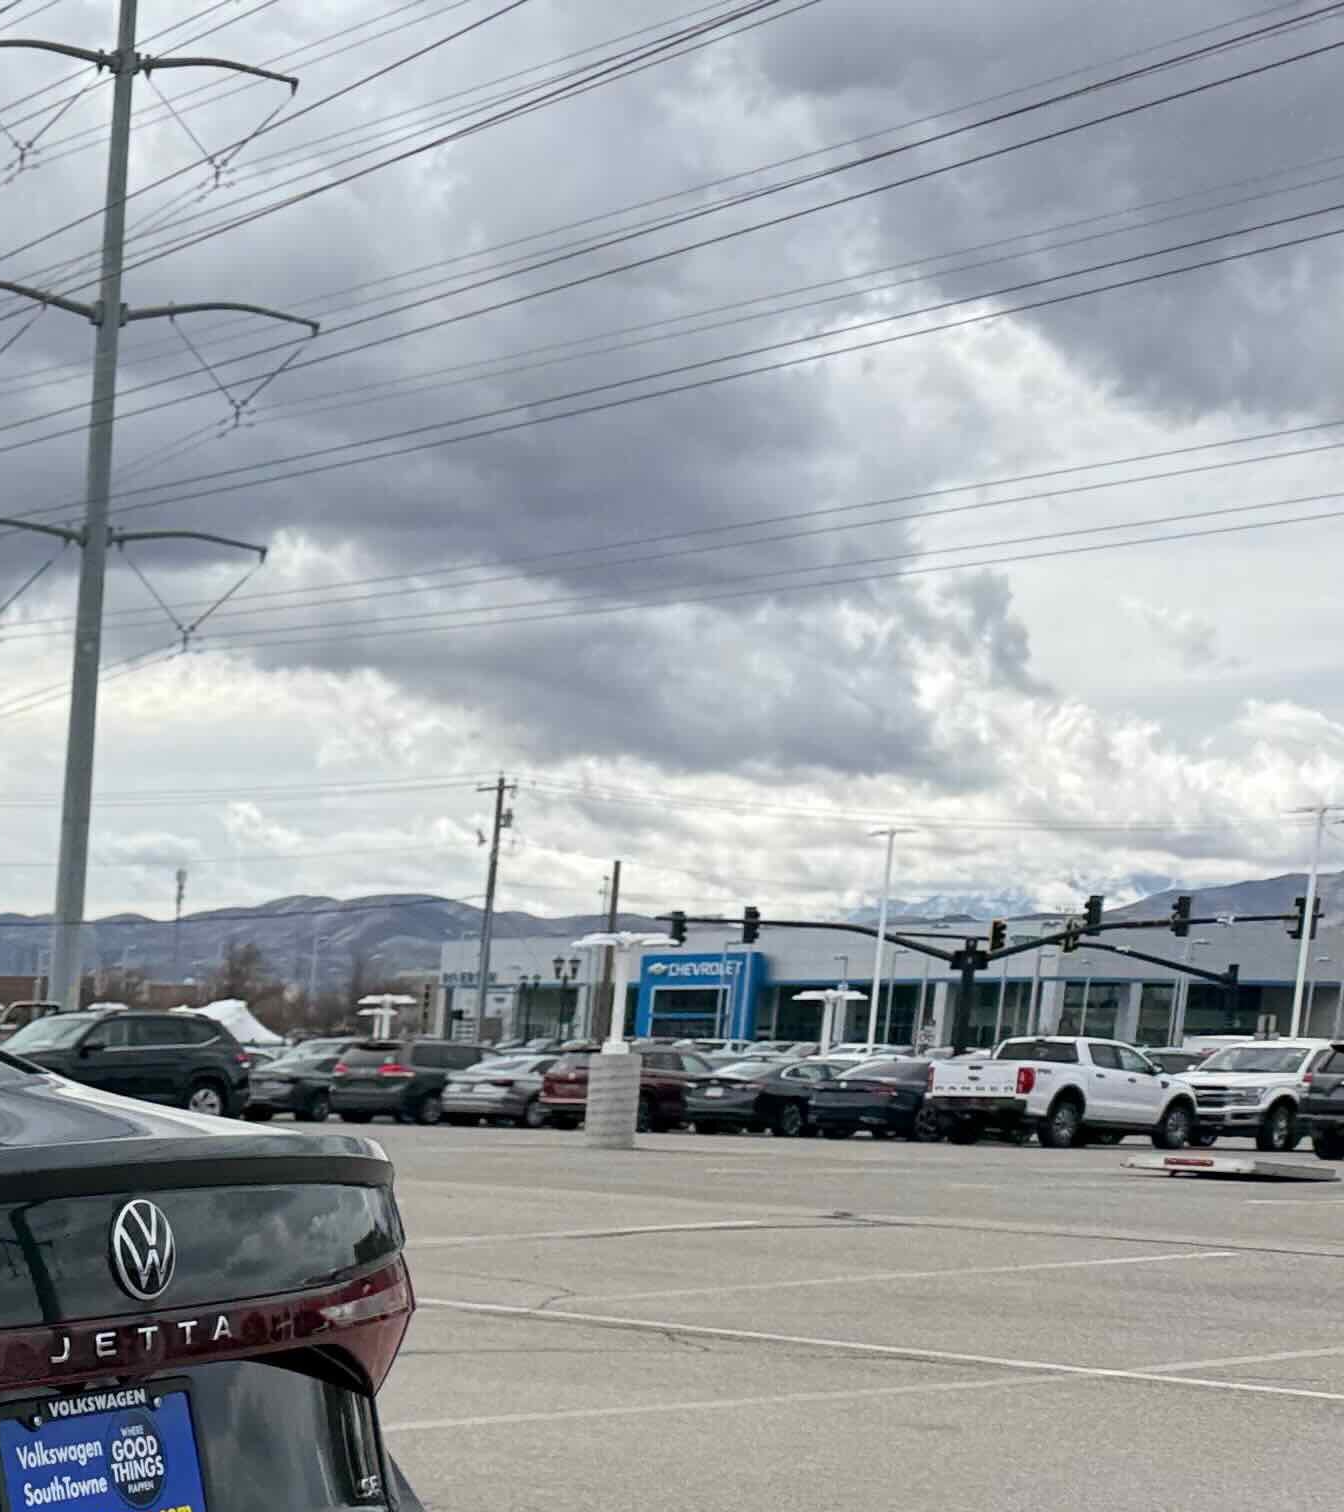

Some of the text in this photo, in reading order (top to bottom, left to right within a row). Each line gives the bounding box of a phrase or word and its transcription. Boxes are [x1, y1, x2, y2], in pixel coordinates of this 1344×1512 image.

[668, 961, 743, 976] CHEVROLET
[50, 1315, 233, 1364] JETTA
[48, 1388, 146, 1418] VOLKSWAGEN
[120, 1424, 144, 1437] WHERE
[16, 1440, 103, 1470] Volkswagen
[112, 1435, 158, 1462] GOOD
[111, 1455, 165, 1483] THINGS
[23, 1475, 108, 1507] SouthTowne
[127, 1480, 154, 1494] HAPPEN
